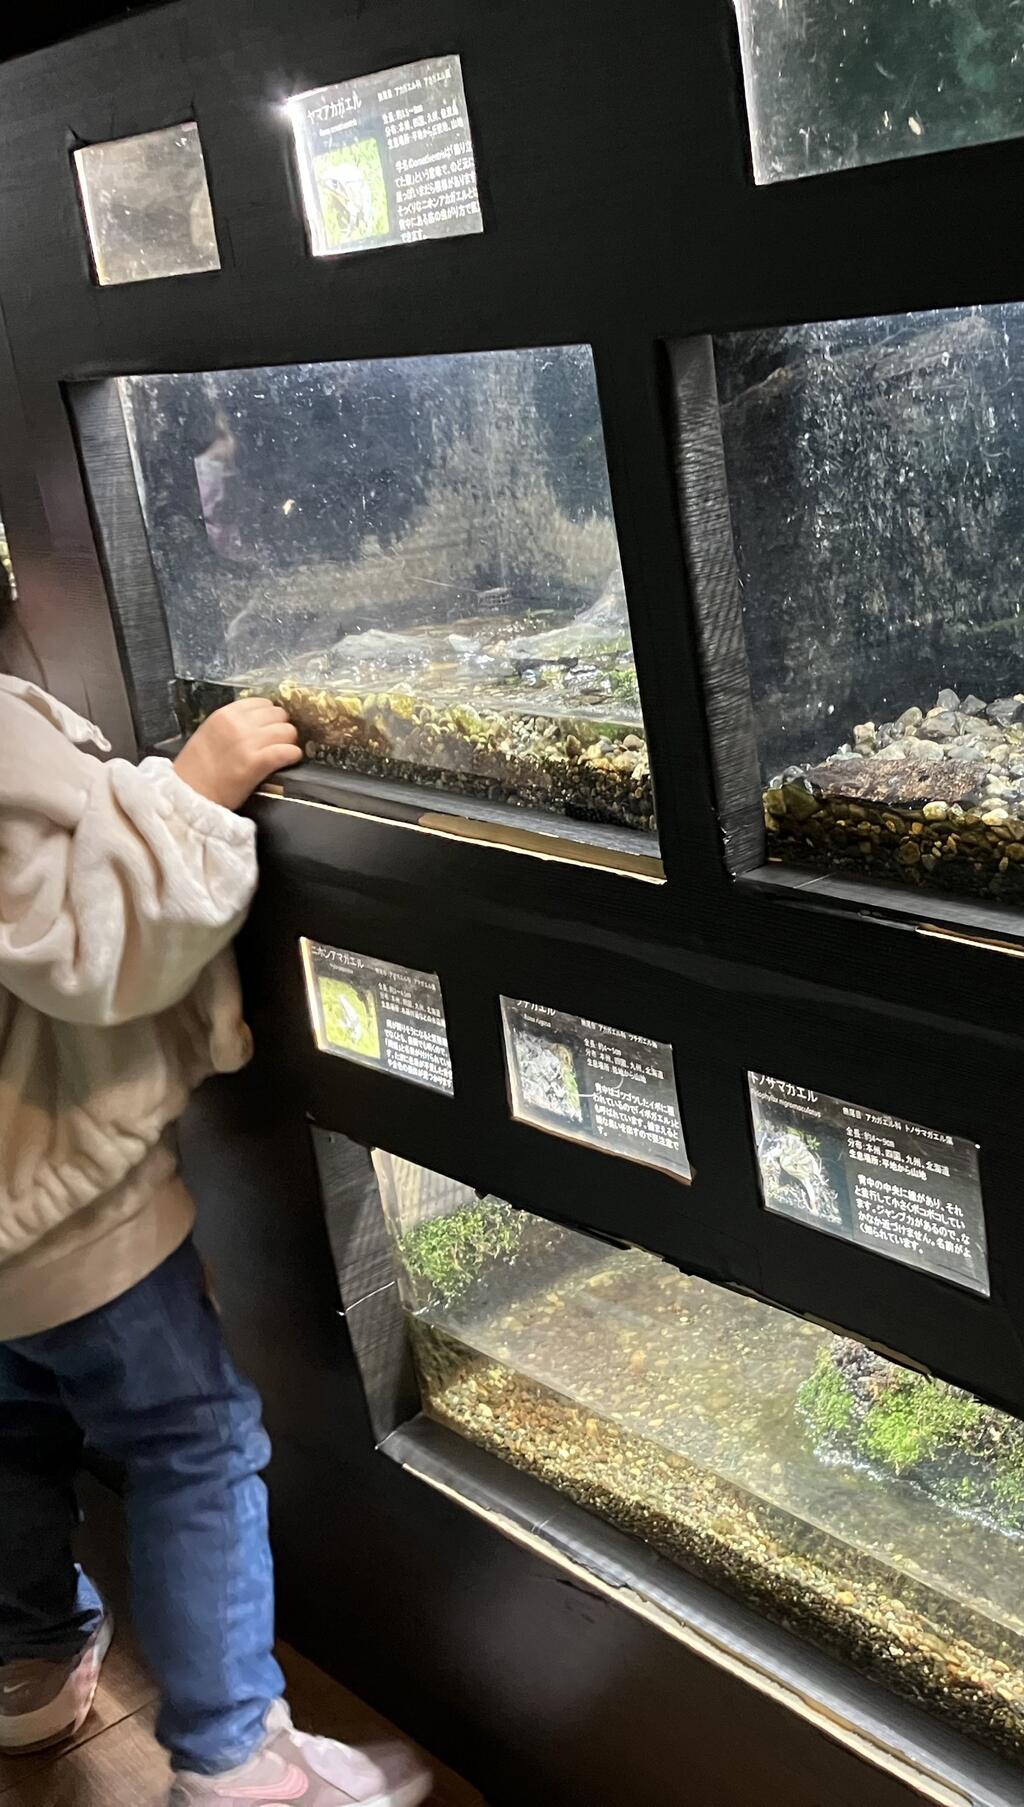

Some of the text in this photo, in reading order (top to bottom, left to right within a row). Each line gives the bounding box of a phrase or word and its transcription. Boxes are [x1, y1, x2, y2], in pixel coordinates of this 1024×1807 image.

[308, 91, 362, 124] ヤマアカガエル
[311, 945, 363, 968] ニホンアマガエル
[750, 1071, 817, 1103] トノサマガエル
[859, 1222, 922, 1254] く知られています。
